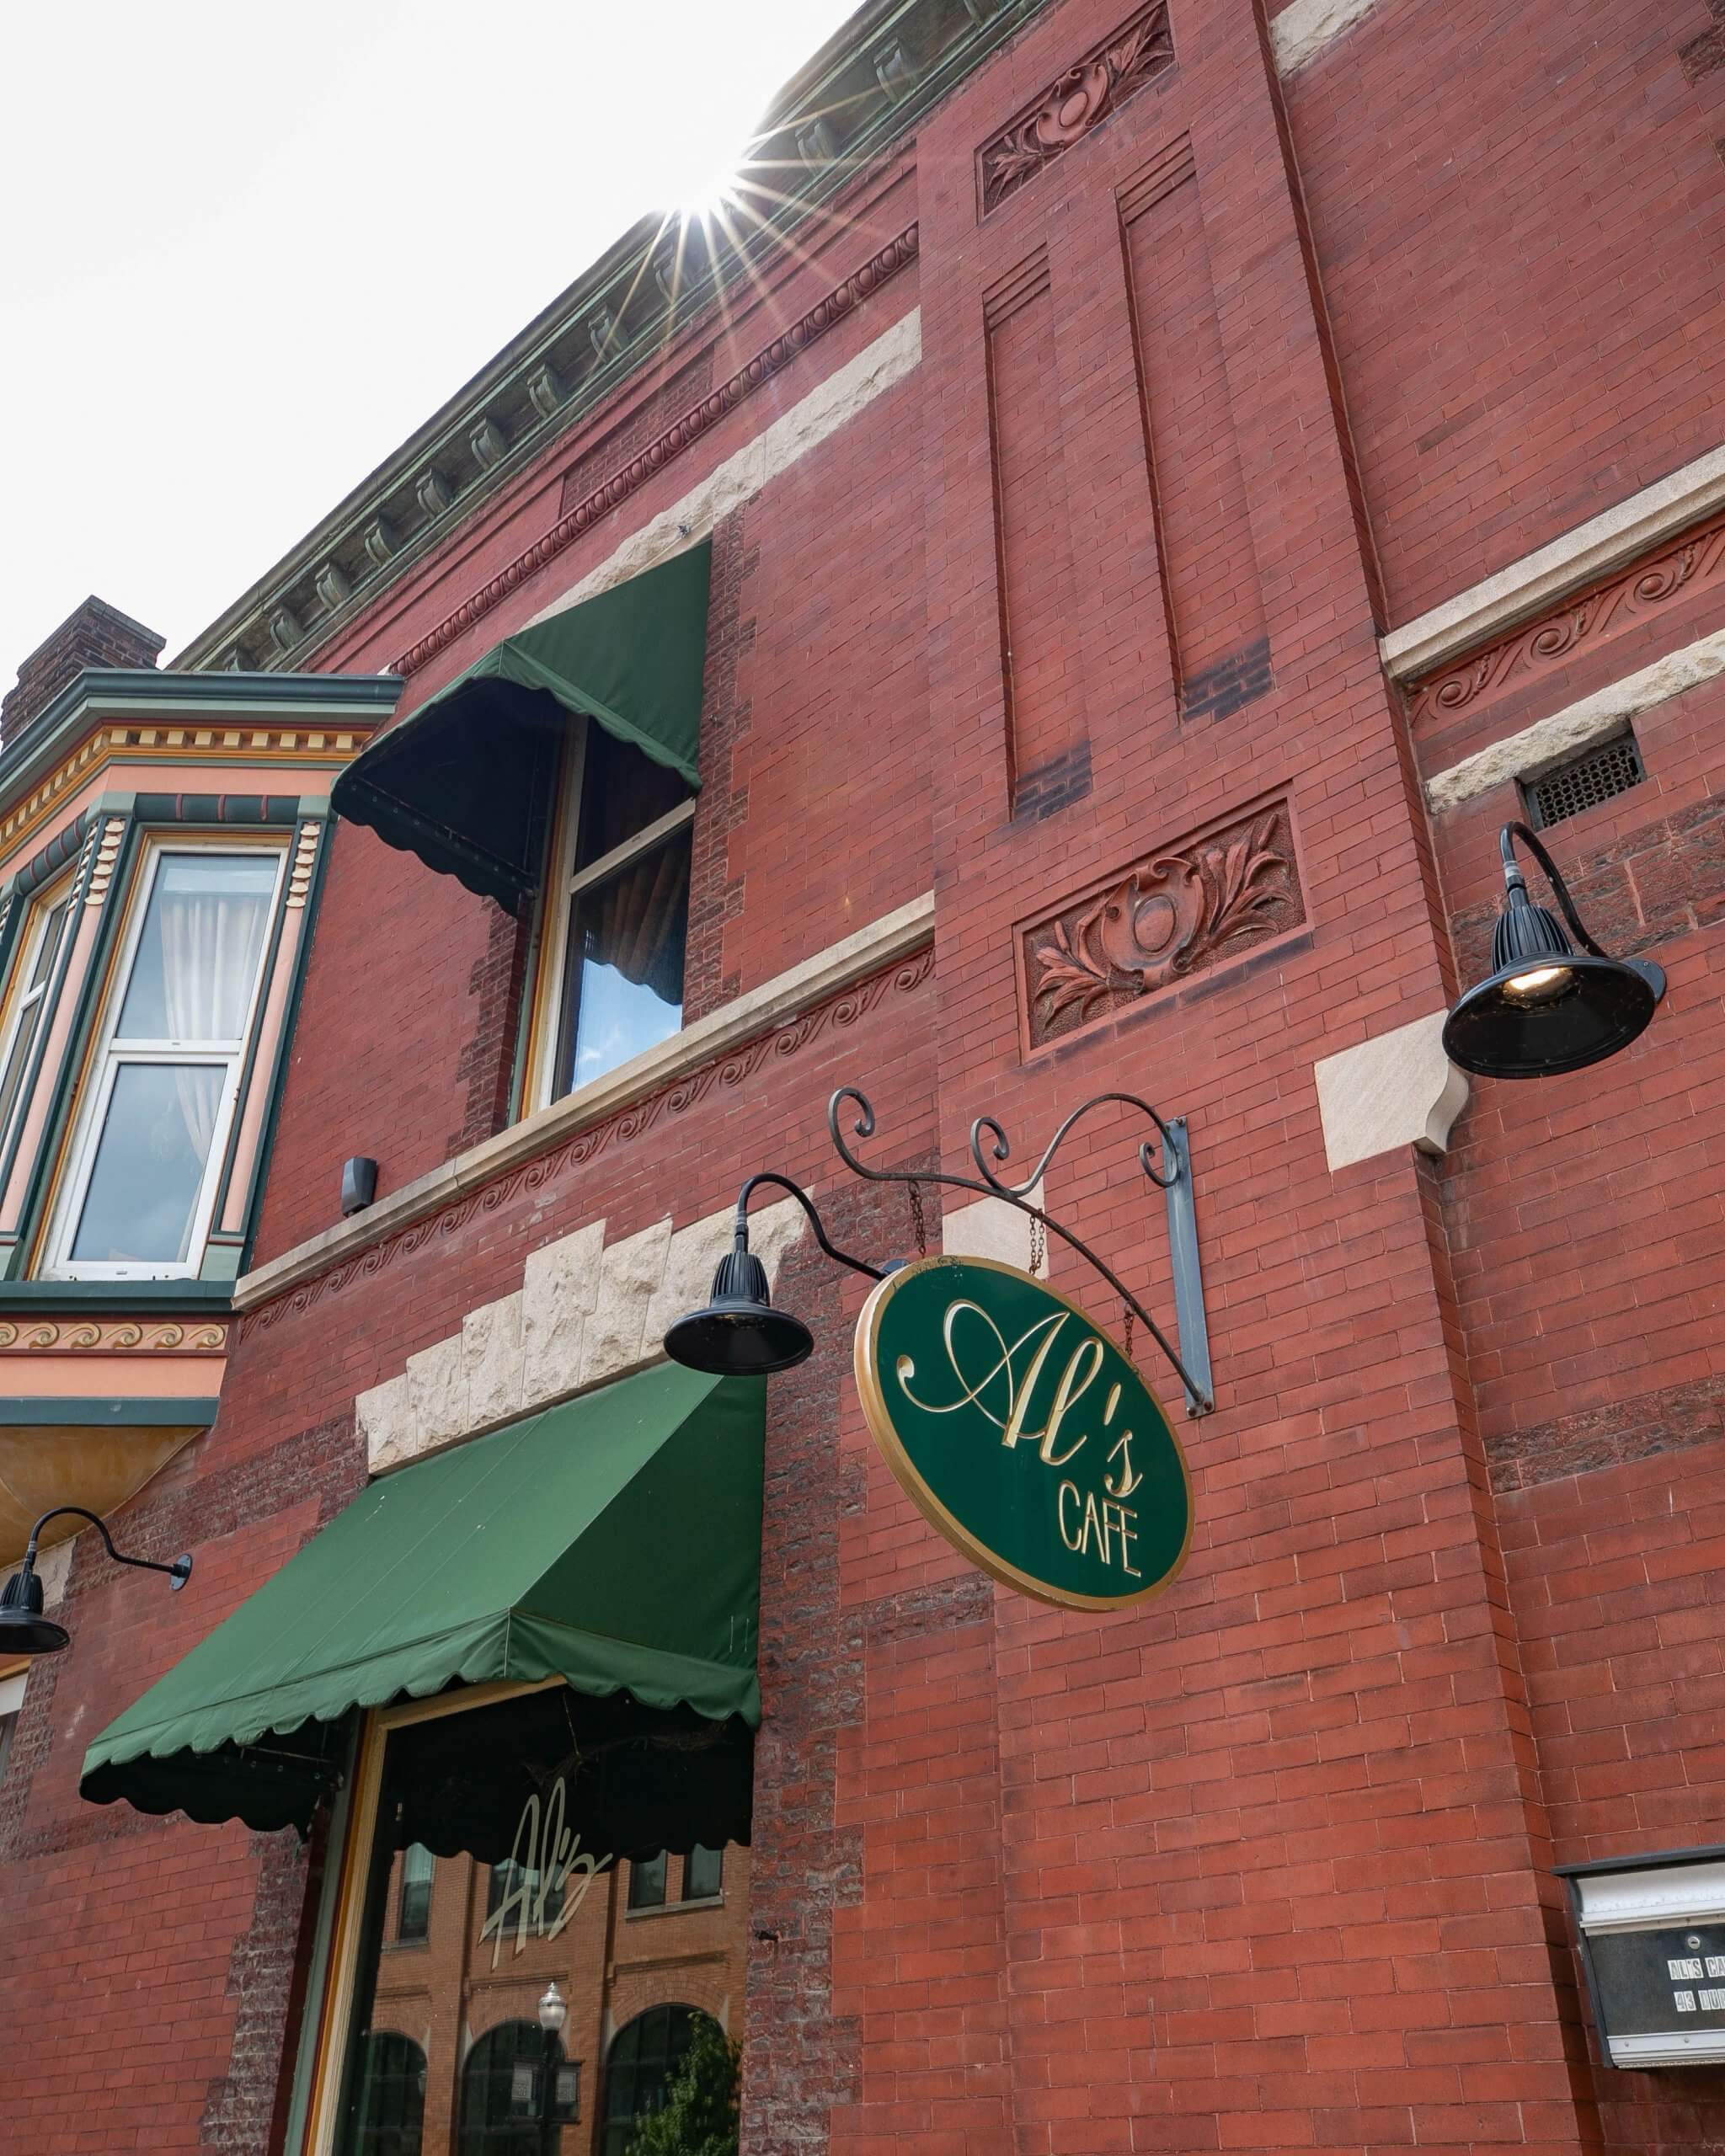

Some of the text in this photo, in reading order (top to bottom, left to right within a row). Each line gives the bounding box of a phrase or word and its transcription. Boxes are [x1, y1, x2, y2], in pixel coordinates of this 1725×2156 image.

[896, 1299, 1143, 1497] Al's
[1059, 1480, 1141, 1577] CAFE
[478, 1777, 613, 1971] Al's
[1669, 1959, 1702, 1979] AL'S
[1676, 1992, 1695, 2010] 43
